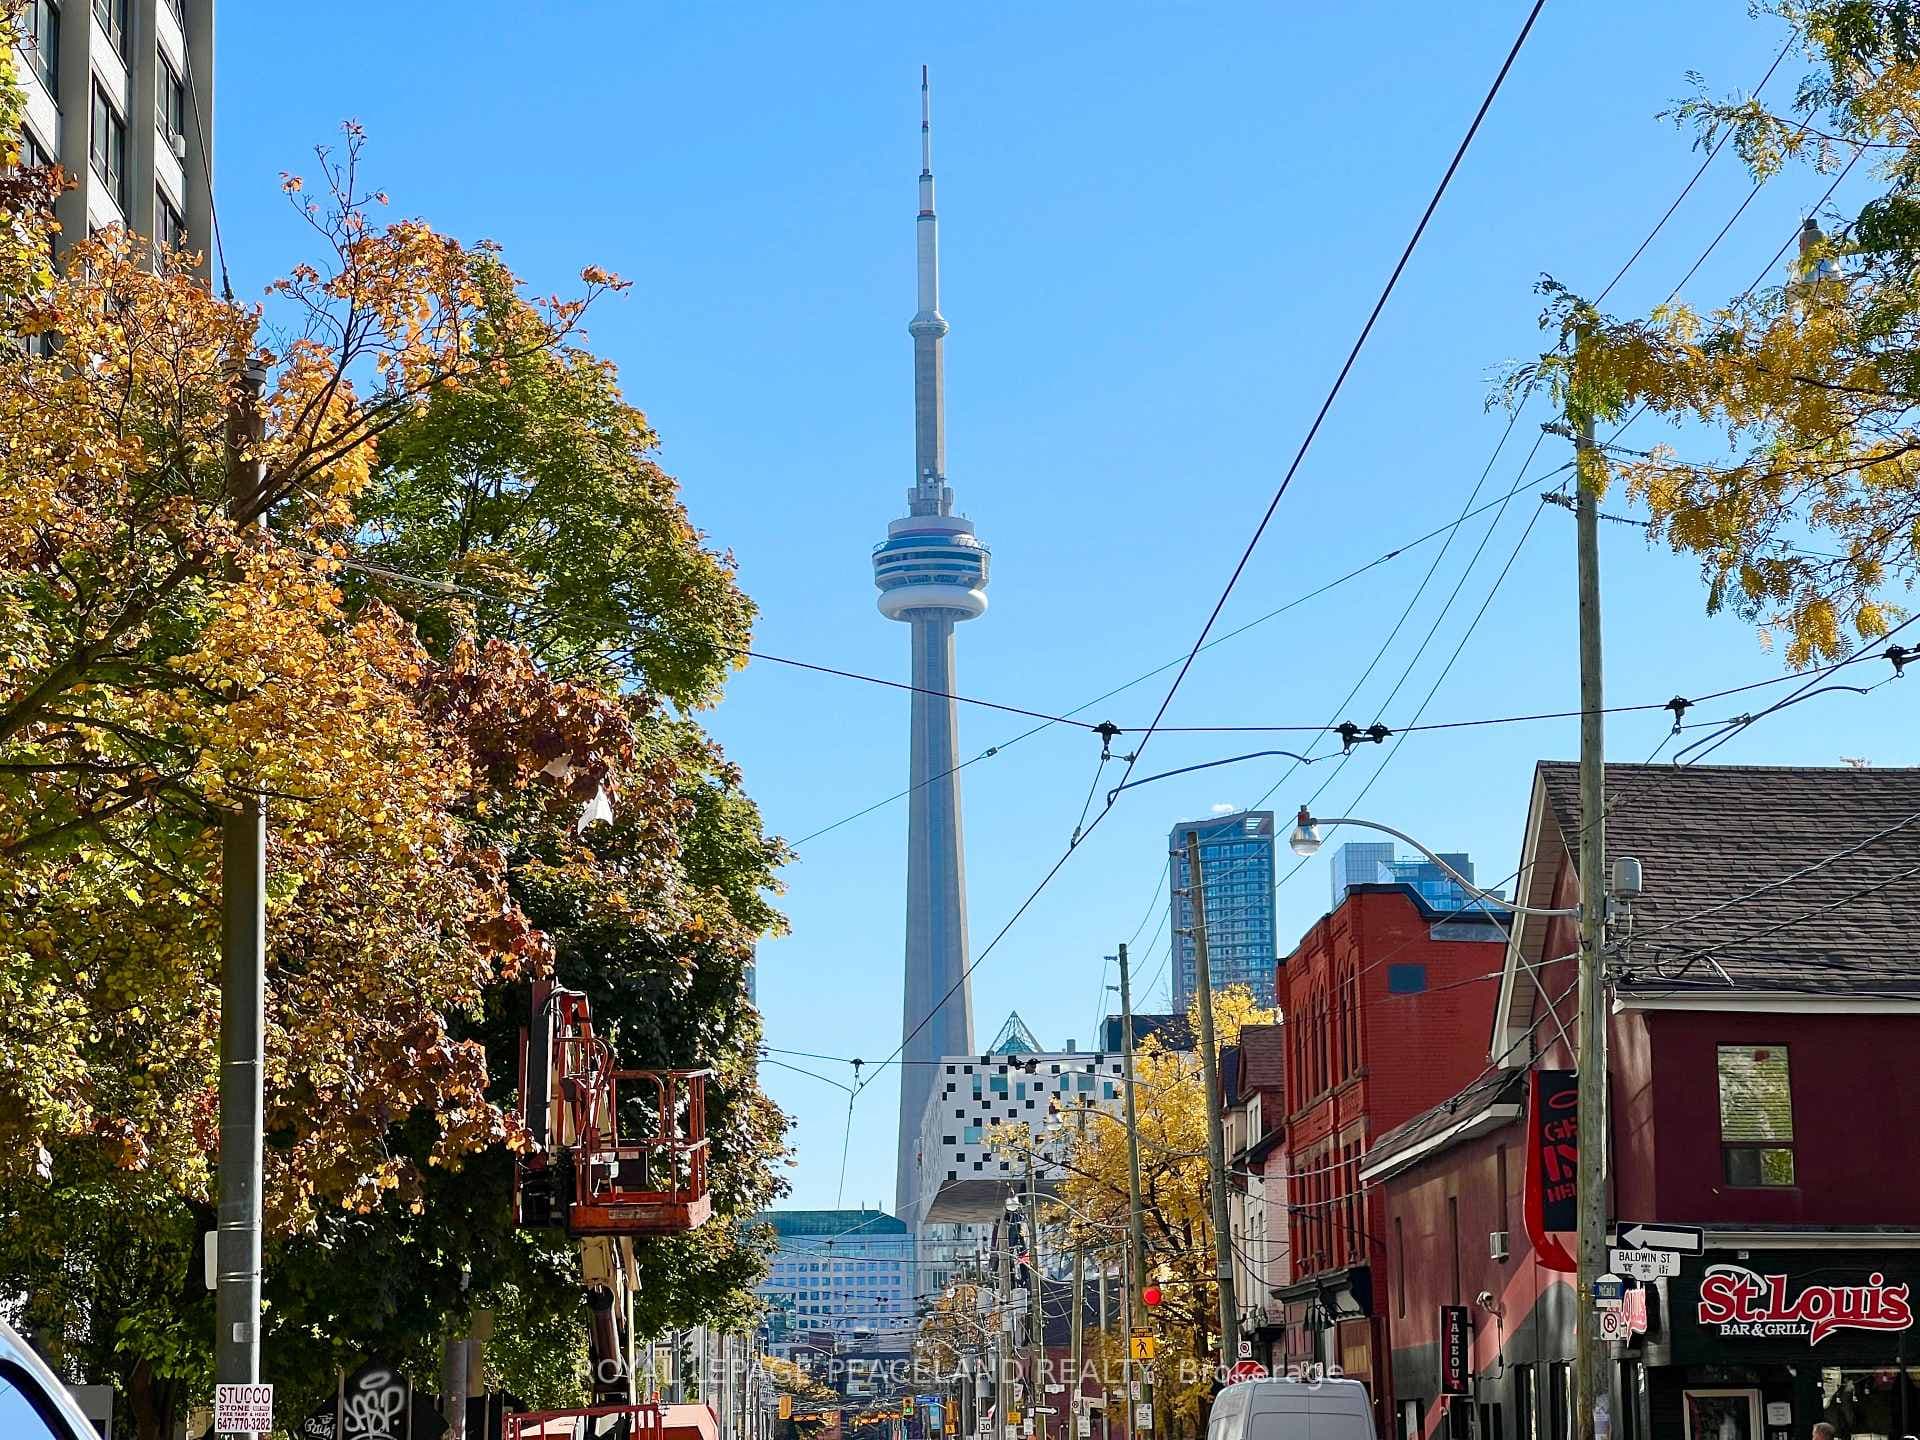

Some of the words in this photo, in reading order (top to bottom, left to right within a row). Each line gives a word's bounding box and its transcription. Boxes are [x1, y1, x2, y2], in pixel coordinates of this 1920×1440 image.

[1618, 1251, 1657, 1263] BALDWIN
[1450, 1311, 1461, 1390] TAKEOUT
[219, 1387, 270, 1404] STUCCO
[219, 1404, 250, 1412] STONE
[217, 1418, 271, 1431] 647-770-3282
[980, 1423, 991, 1431] 30
